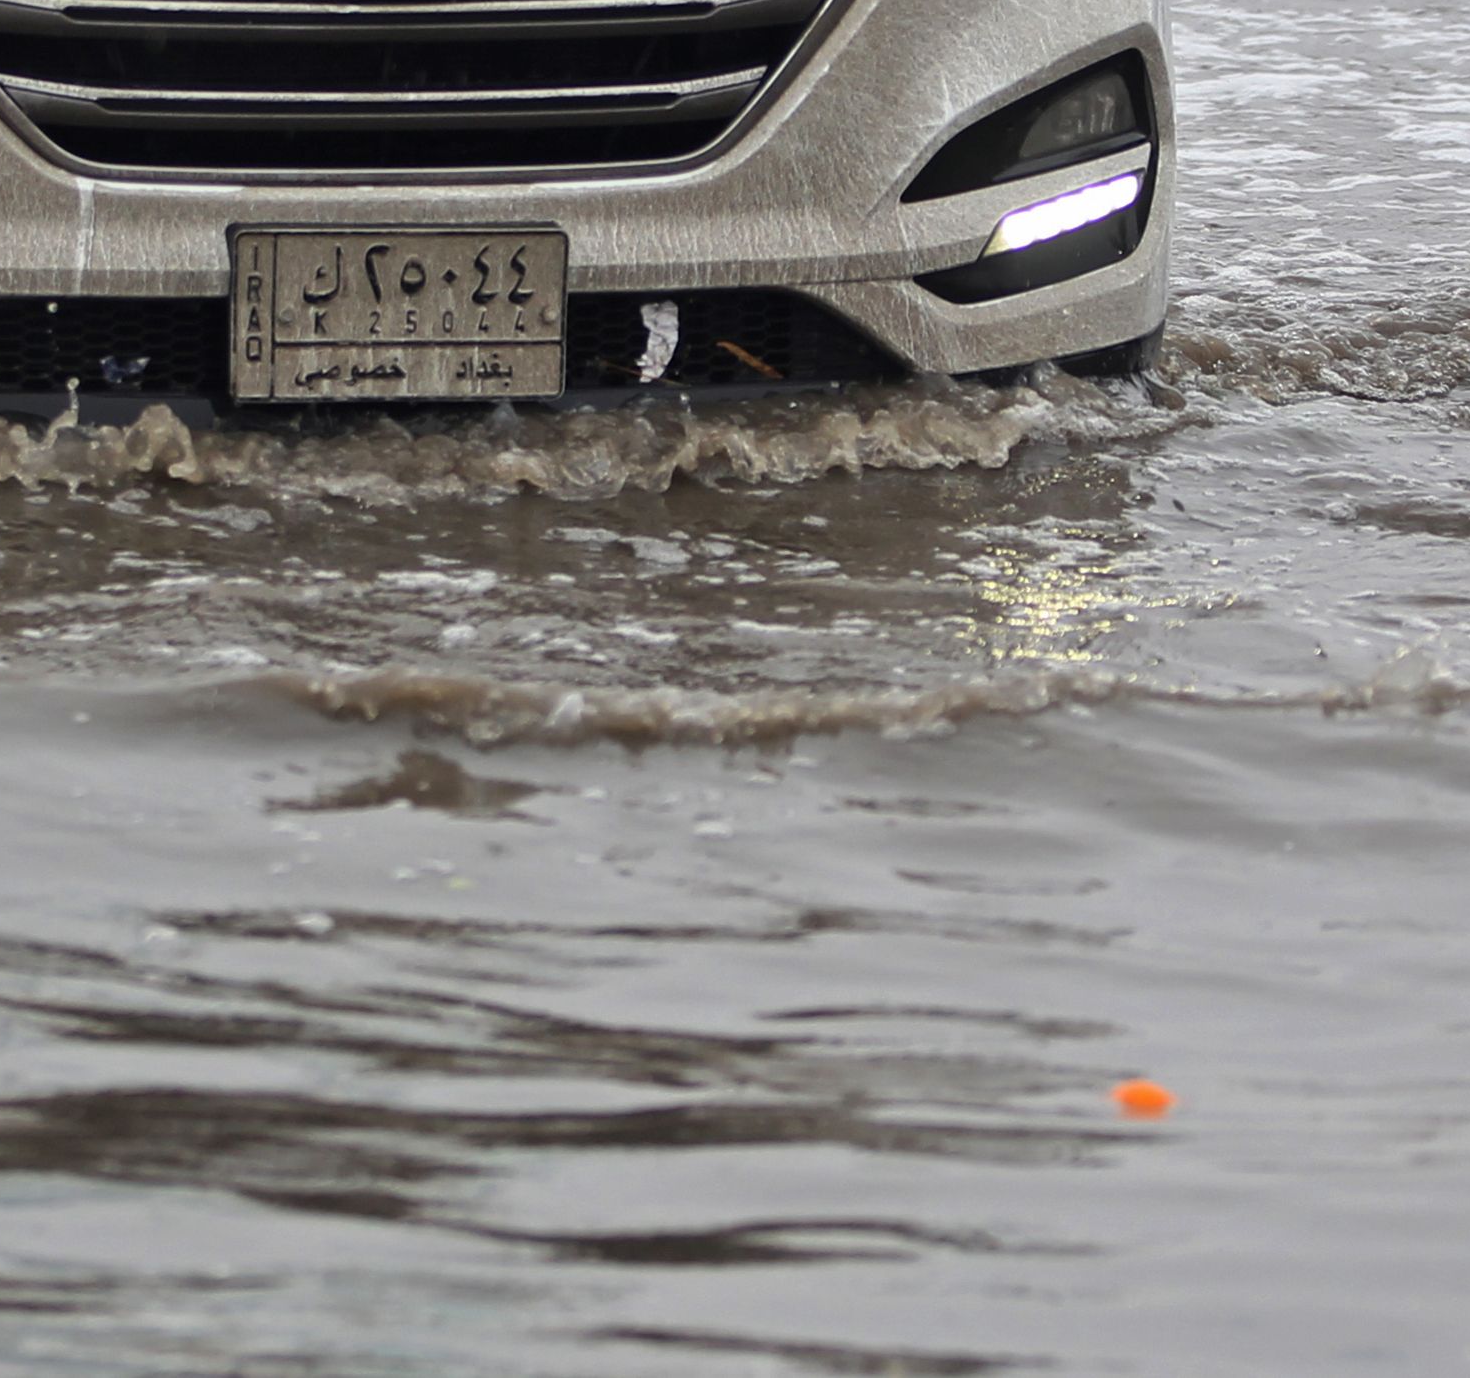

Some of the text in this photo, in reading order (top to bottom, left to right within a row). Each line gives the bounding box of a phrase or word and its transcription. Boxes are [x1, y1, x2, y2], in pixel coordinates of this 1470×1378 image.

[244, 246, 263, 363] IRAQ
[293, 352, 514, 391] بغداد خصوصي
